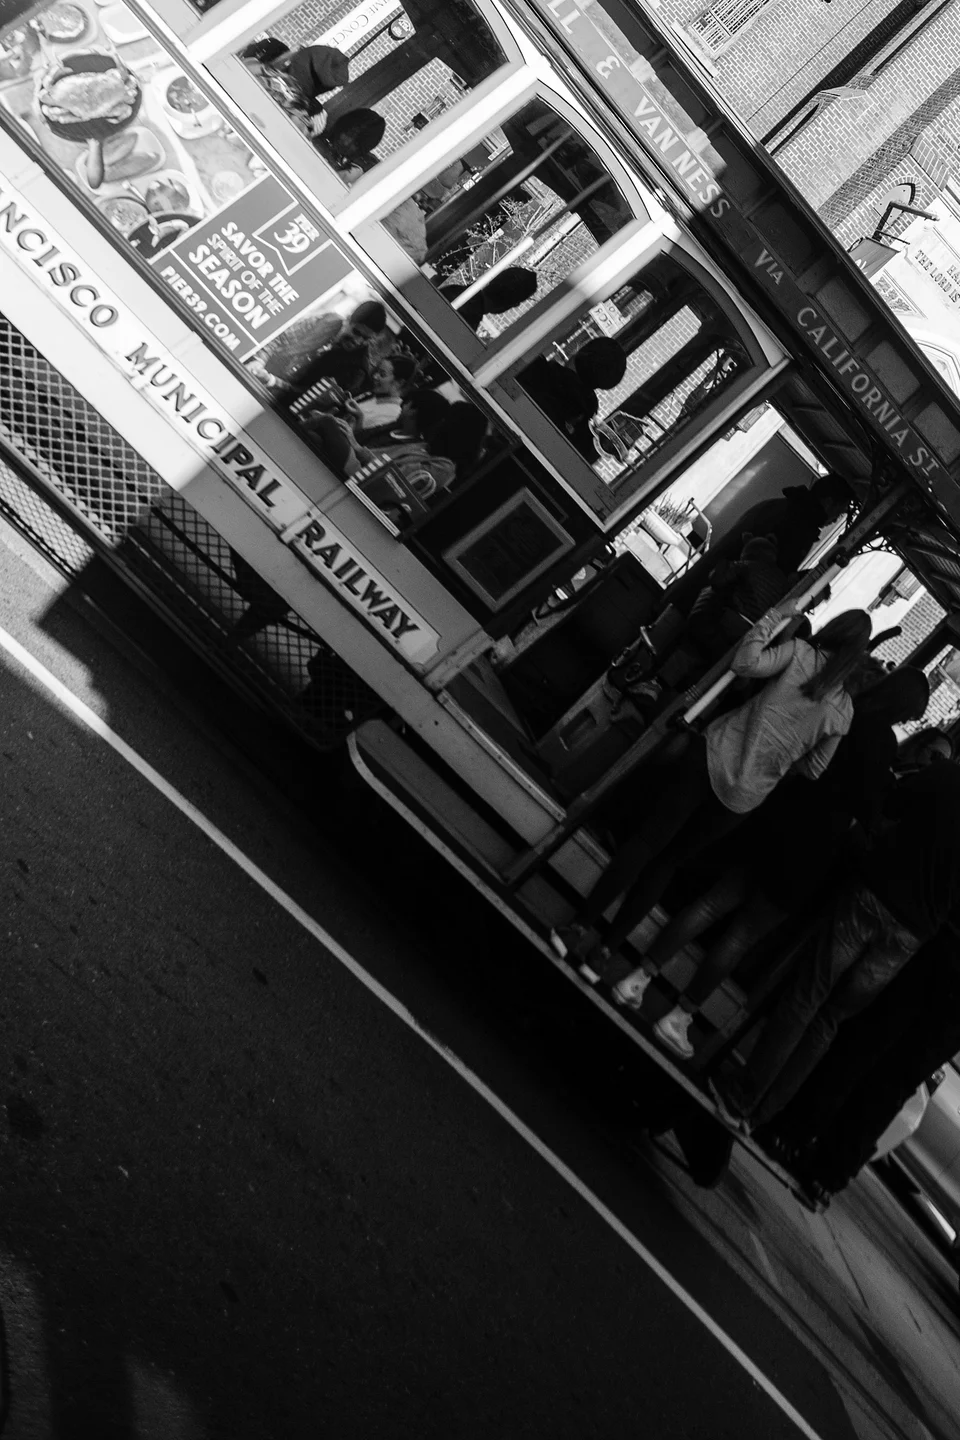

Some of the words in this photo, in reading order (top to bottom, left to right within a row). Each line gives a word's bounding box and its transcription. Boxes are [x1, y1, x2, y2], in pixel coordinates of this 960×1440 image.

[221, 222, 274, 278] SAVOR
[268, 272, 299, 305] THE
[274, 222, 310, 253] 39
[294, 213, 320, 242] PIER
[595, 55, 622, 79] &
[633, 95, 683, 154] VAN
[669, 150, 731, 218] NESS
[797, 307, 911, 448] CALIFORNIA
[160, 265, 240, 351] PIER39.COM
[189, 245, 271, 329] SEASON
[207, 233, 245, 271] SPIRIT
[241, 270, 263, 290] OF
[258, 288, 284, 316] THE
[915, 250, 933, 271] THE
[930, 267, 952, 292] LORD
[949, 290, 960, 303] IS
[0, 192, 119, 328] NCISCO
[125, 342, 283, 508] MUNICIPAL
[297, 519, 420, 639] RAILWAY
